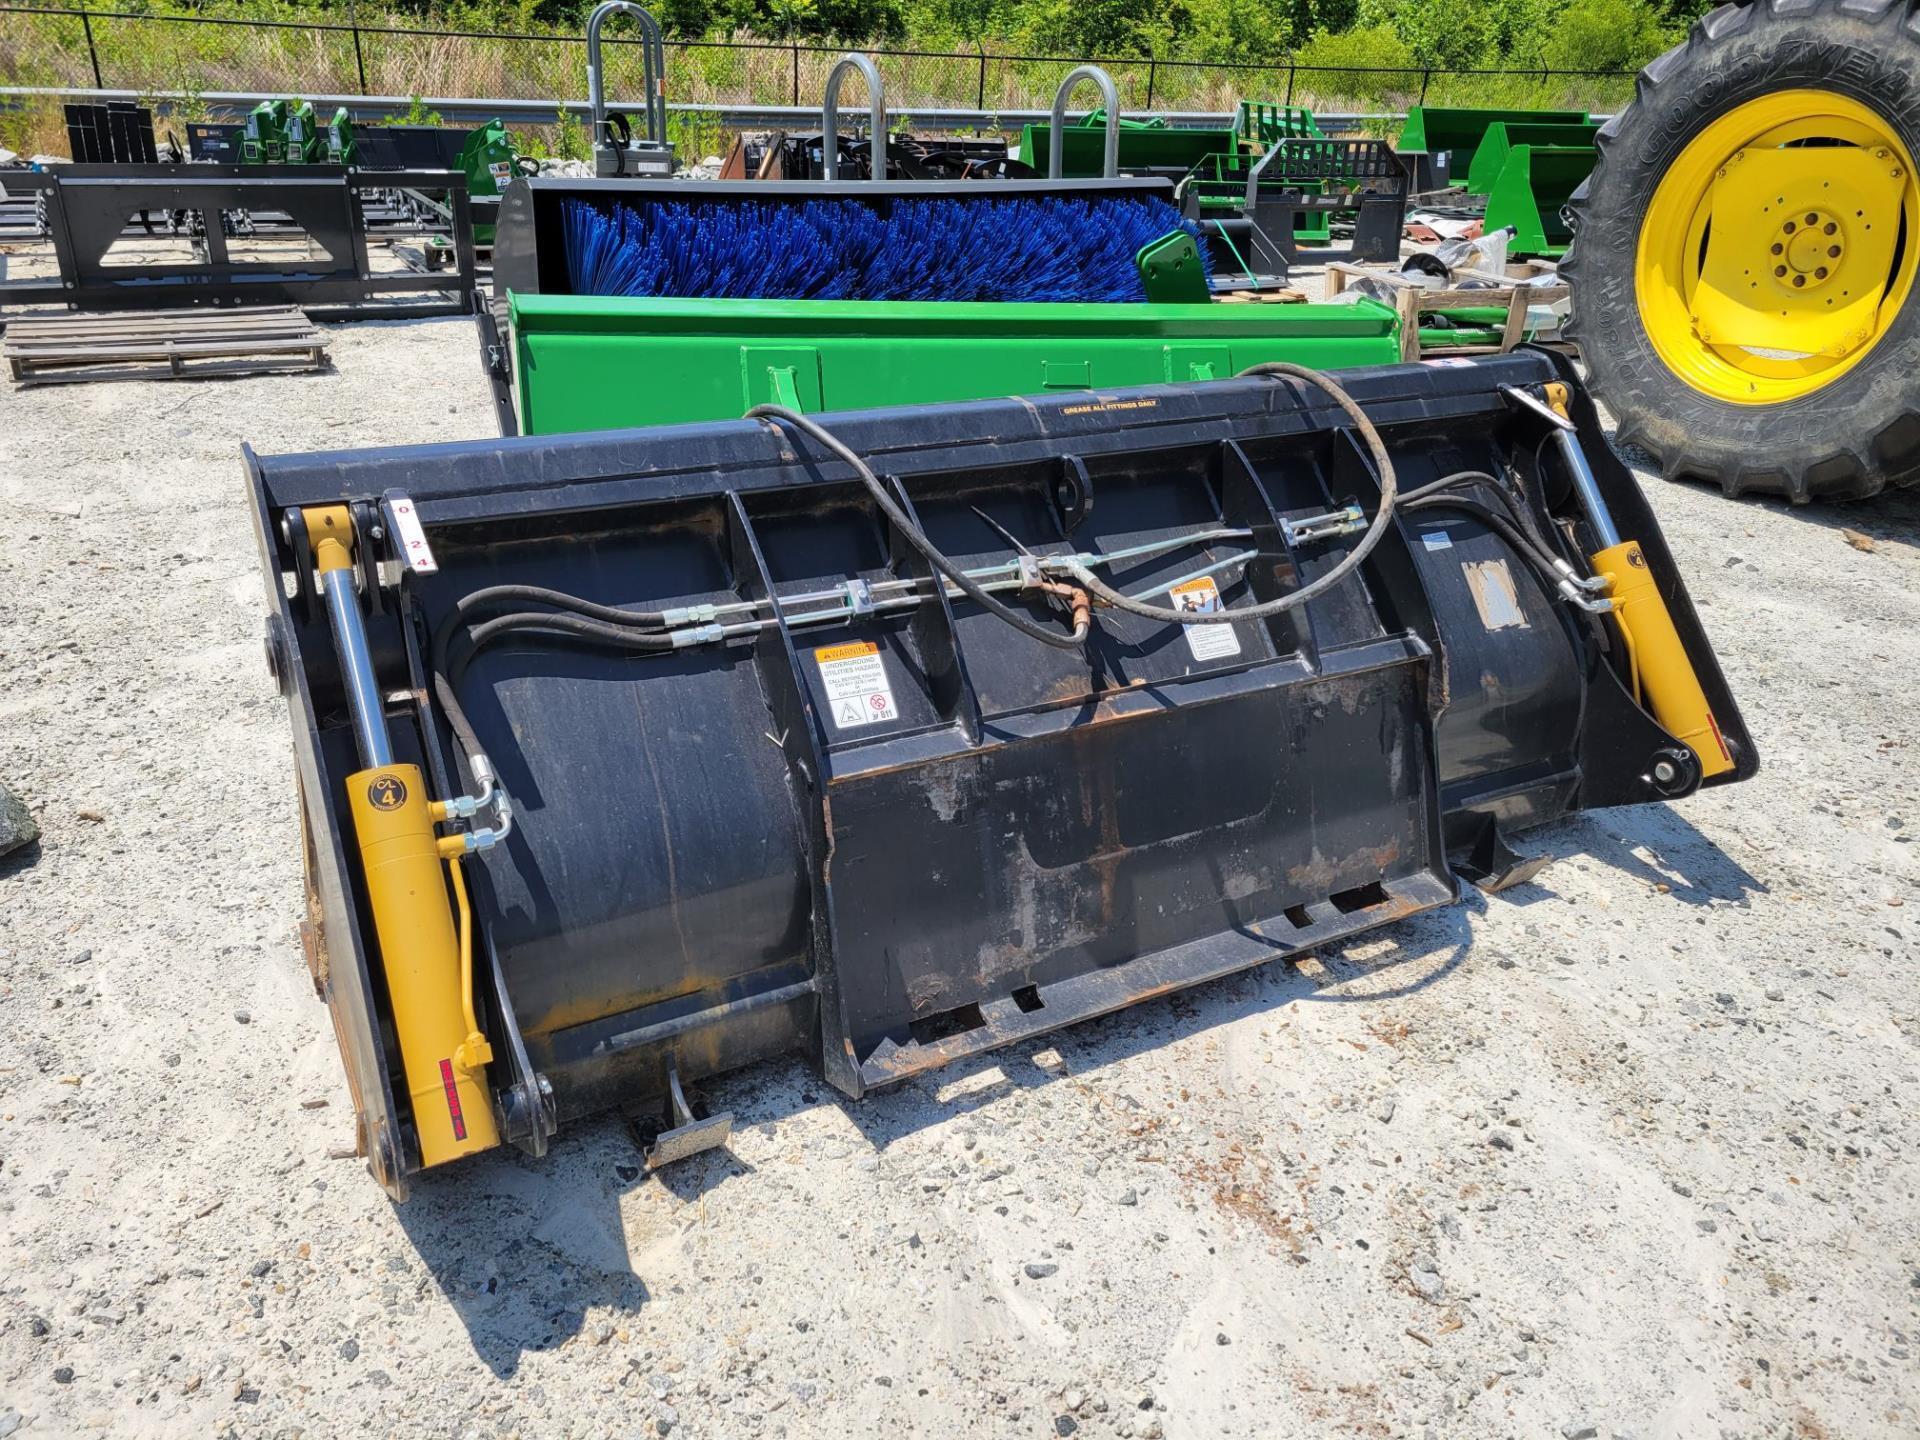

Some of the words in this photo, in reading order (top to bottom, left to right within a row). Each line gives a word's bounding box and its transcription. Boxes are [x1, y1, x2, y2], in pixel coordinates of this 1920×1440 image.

[1063, 406, 1092, 415] GREASE
[1093, 404, 1106, 412] ALL
[1106, 402, 1138, 411] FITTINGS
[1138, 400, 1157, 408] DAILY
[410, 540, 421, 549] 2
[1636, 556, 1643, 566] 4
[832, 645, 872, 659] WARNING
[824, 656, 875, 668] UNDERGROUND
[823, 667, 853, 676] UTILITIES
[854, 663, 880, 671] HAZARD
[382, 789, 396, 806] 4
